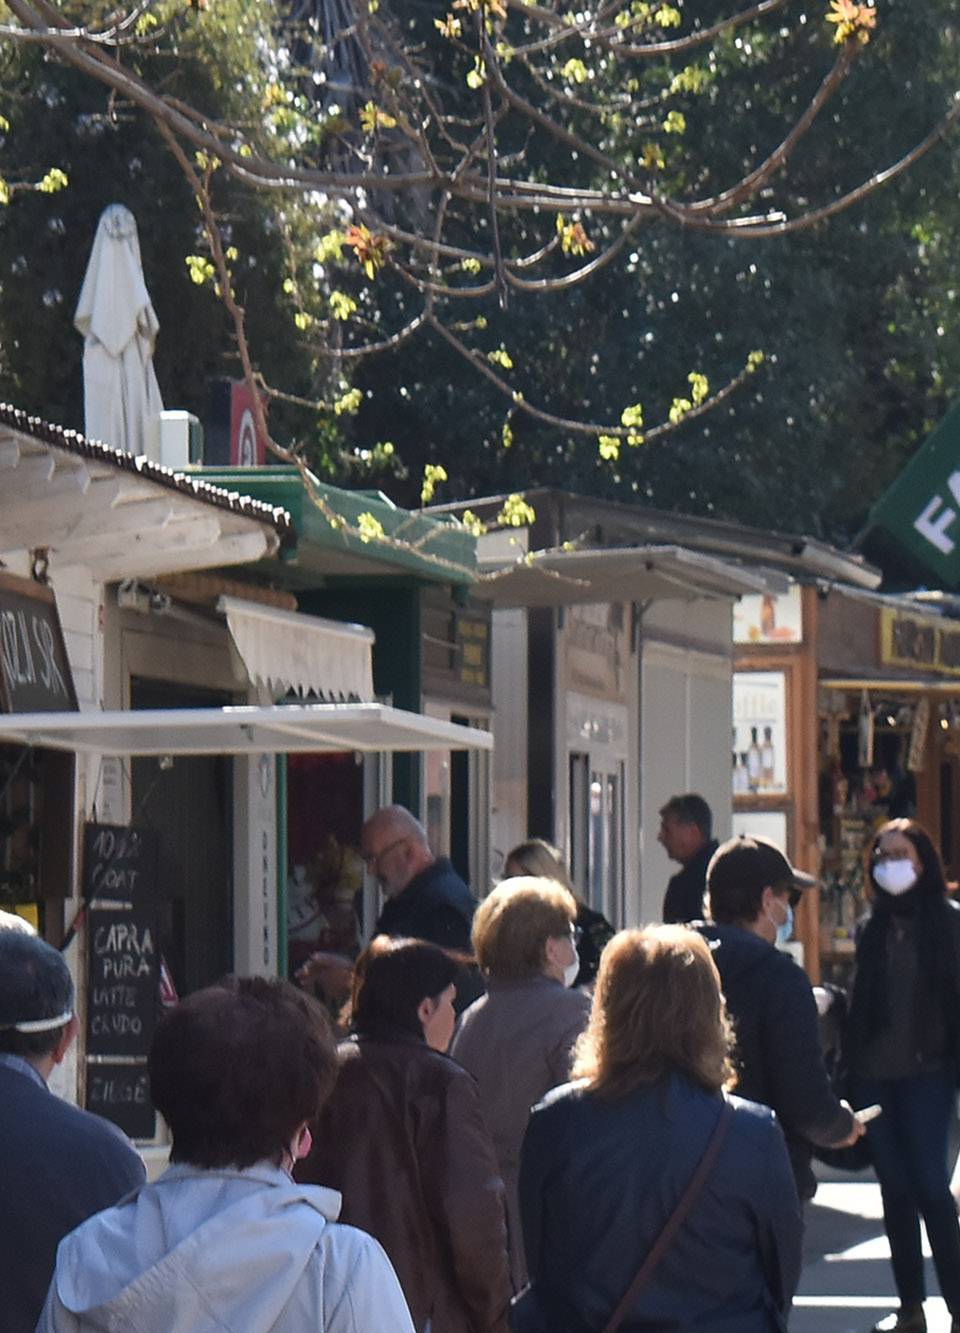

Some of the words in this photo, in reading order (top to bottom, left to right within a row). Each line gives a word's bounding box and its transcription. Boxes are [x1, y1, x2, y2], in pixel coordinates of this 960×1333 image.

[94, 923, 154, 955] CAPRA
[103, 954, 151, 979] PURA
[91, 1013, 142, 1035] CRUDO
